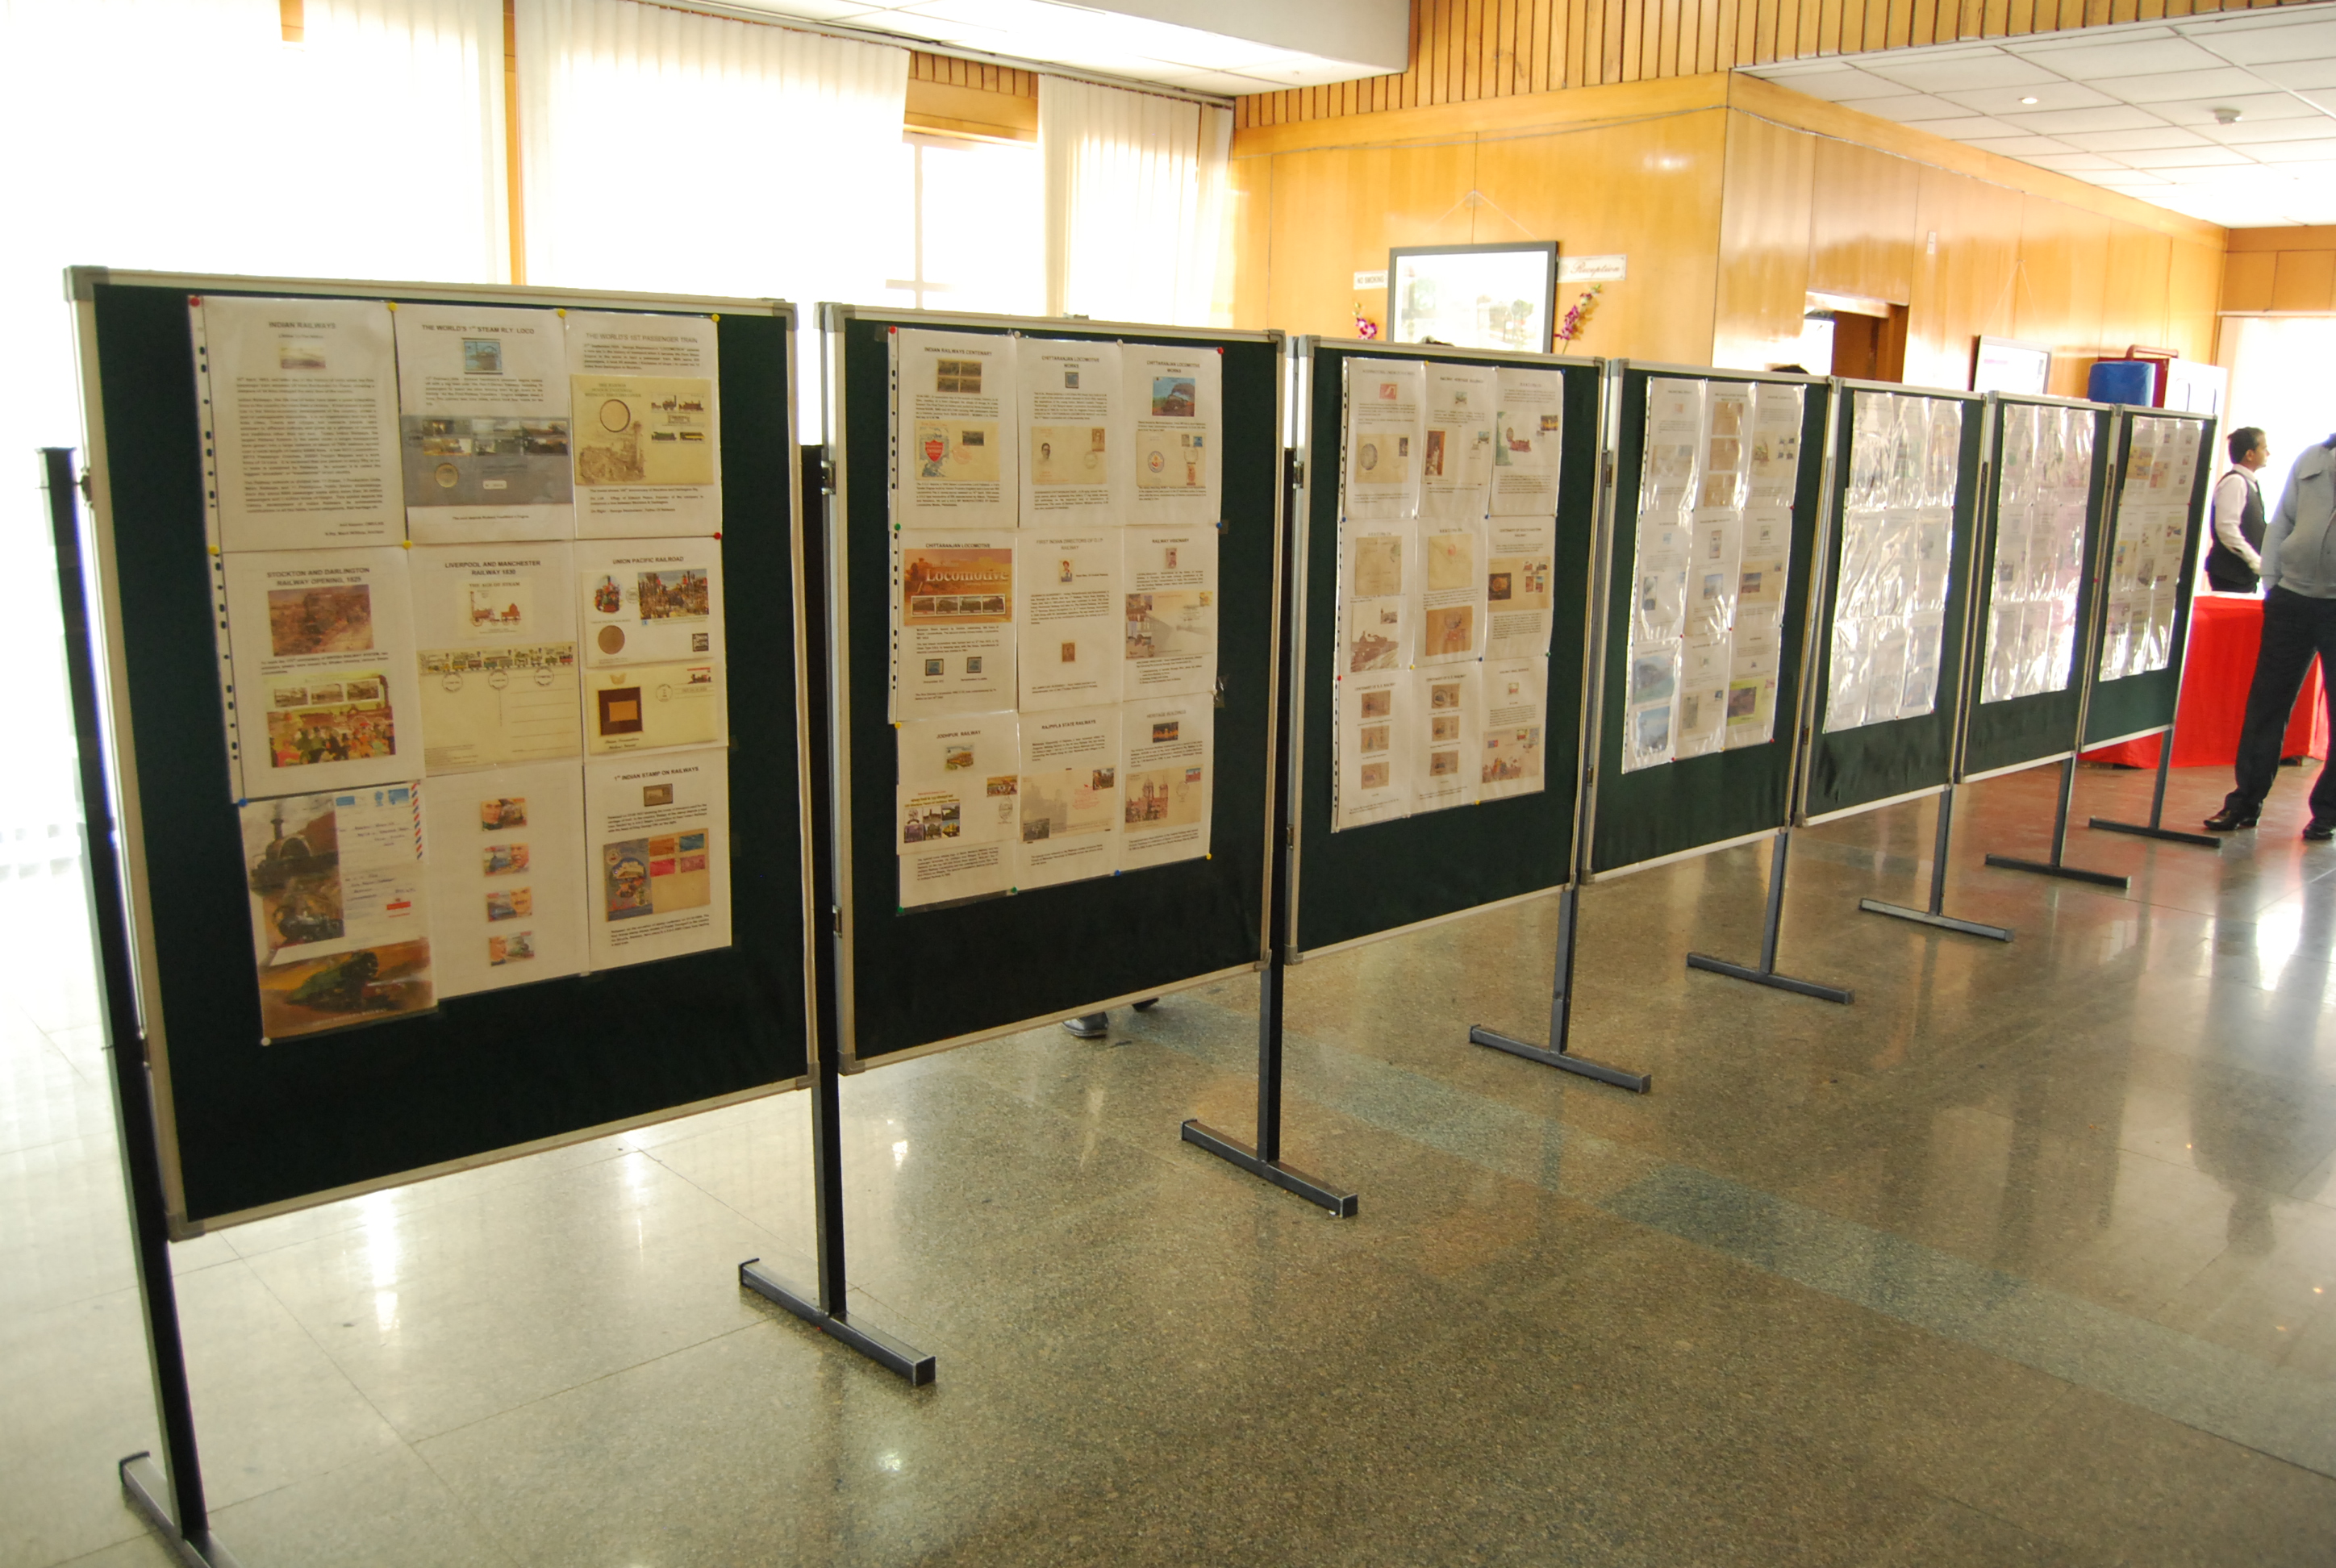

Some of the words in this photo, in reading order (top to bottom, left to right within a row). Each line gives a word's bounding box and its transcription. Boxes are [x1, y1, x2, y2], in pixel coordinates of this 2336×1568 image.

[1571, 261, 1620, 277] Reception
[1365, 275, 1384, 283] SMOKING
[926, 569, 1010, 582] Locomotive
[671, 766, 699, 774] RAILWAYS
